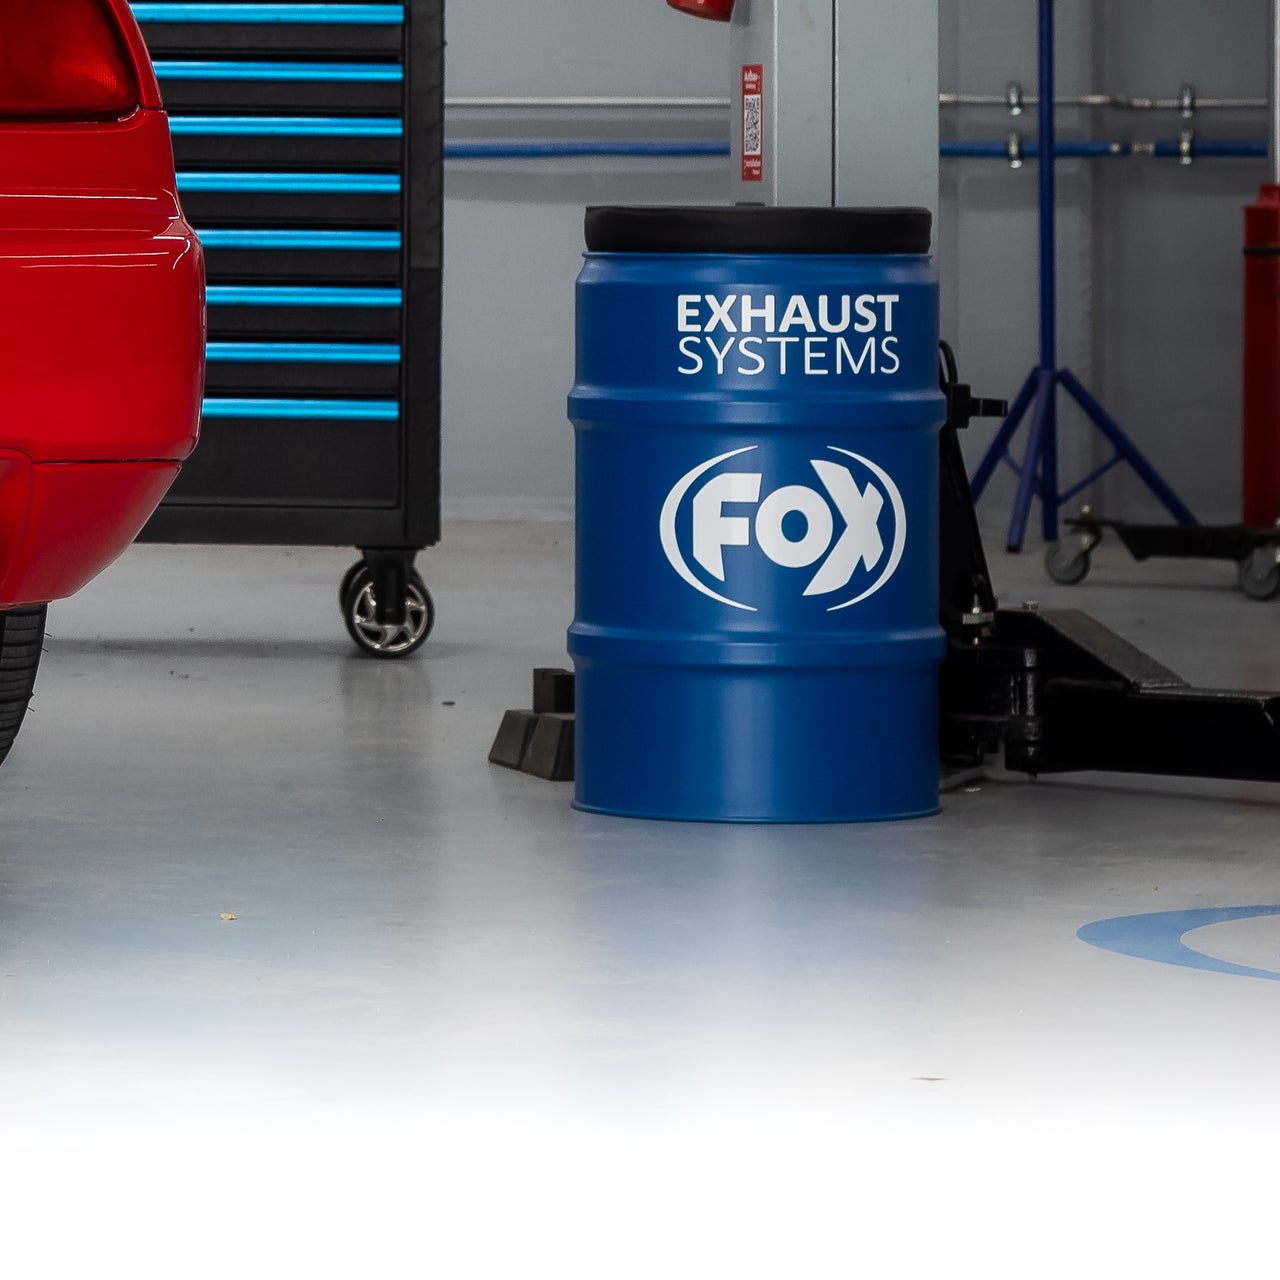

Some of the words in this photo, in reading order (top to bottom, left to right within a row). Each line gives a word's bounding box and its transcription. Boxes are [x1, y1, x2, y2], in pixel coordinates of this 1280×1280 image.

[677, 294, 900, 333] EXHAUST
[677, 336, 901, 375] SYSTEMS
[693, 459, 884, 596] FOX
